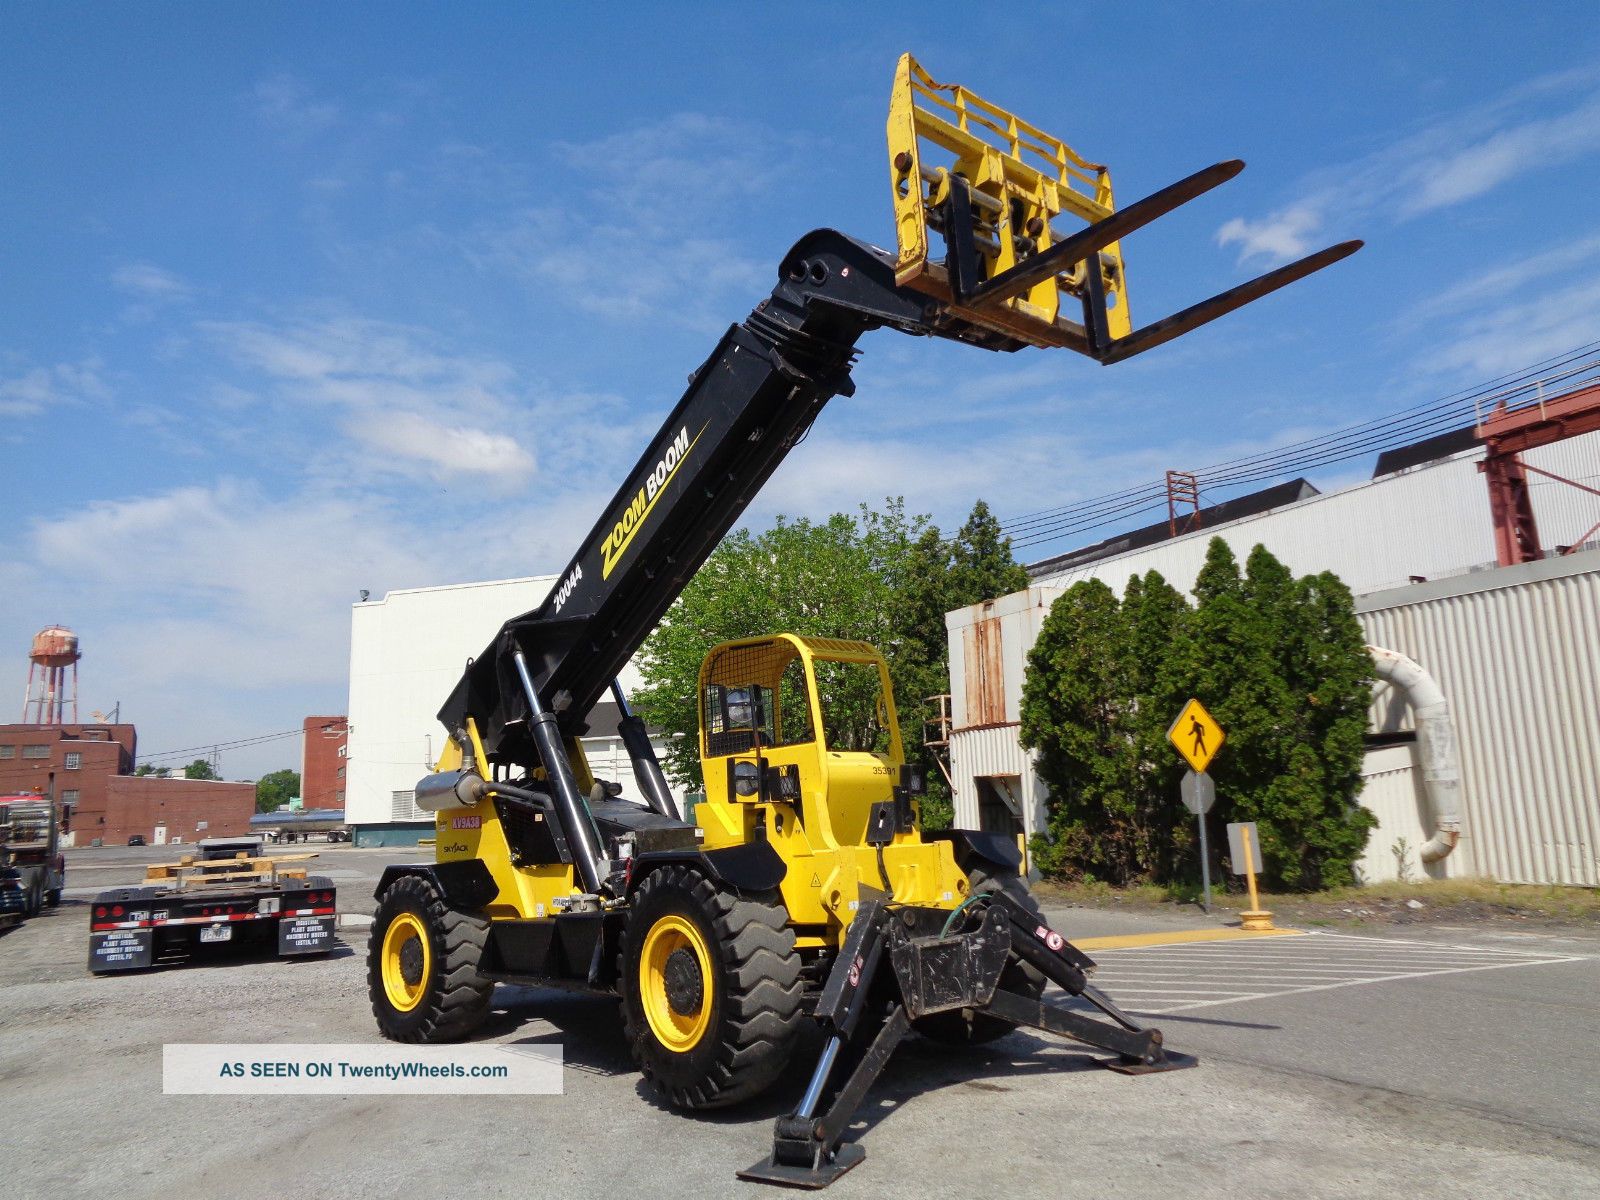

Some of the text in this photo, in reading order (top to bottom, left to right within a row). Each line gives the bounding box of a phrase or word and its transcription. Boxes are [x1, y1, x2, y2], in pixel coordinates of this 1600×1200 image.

[601, 426, 689, 581] ZOOM BOOM
[553, 562, 583, 614] 20044
[872, 766, 896, 776] 35391
